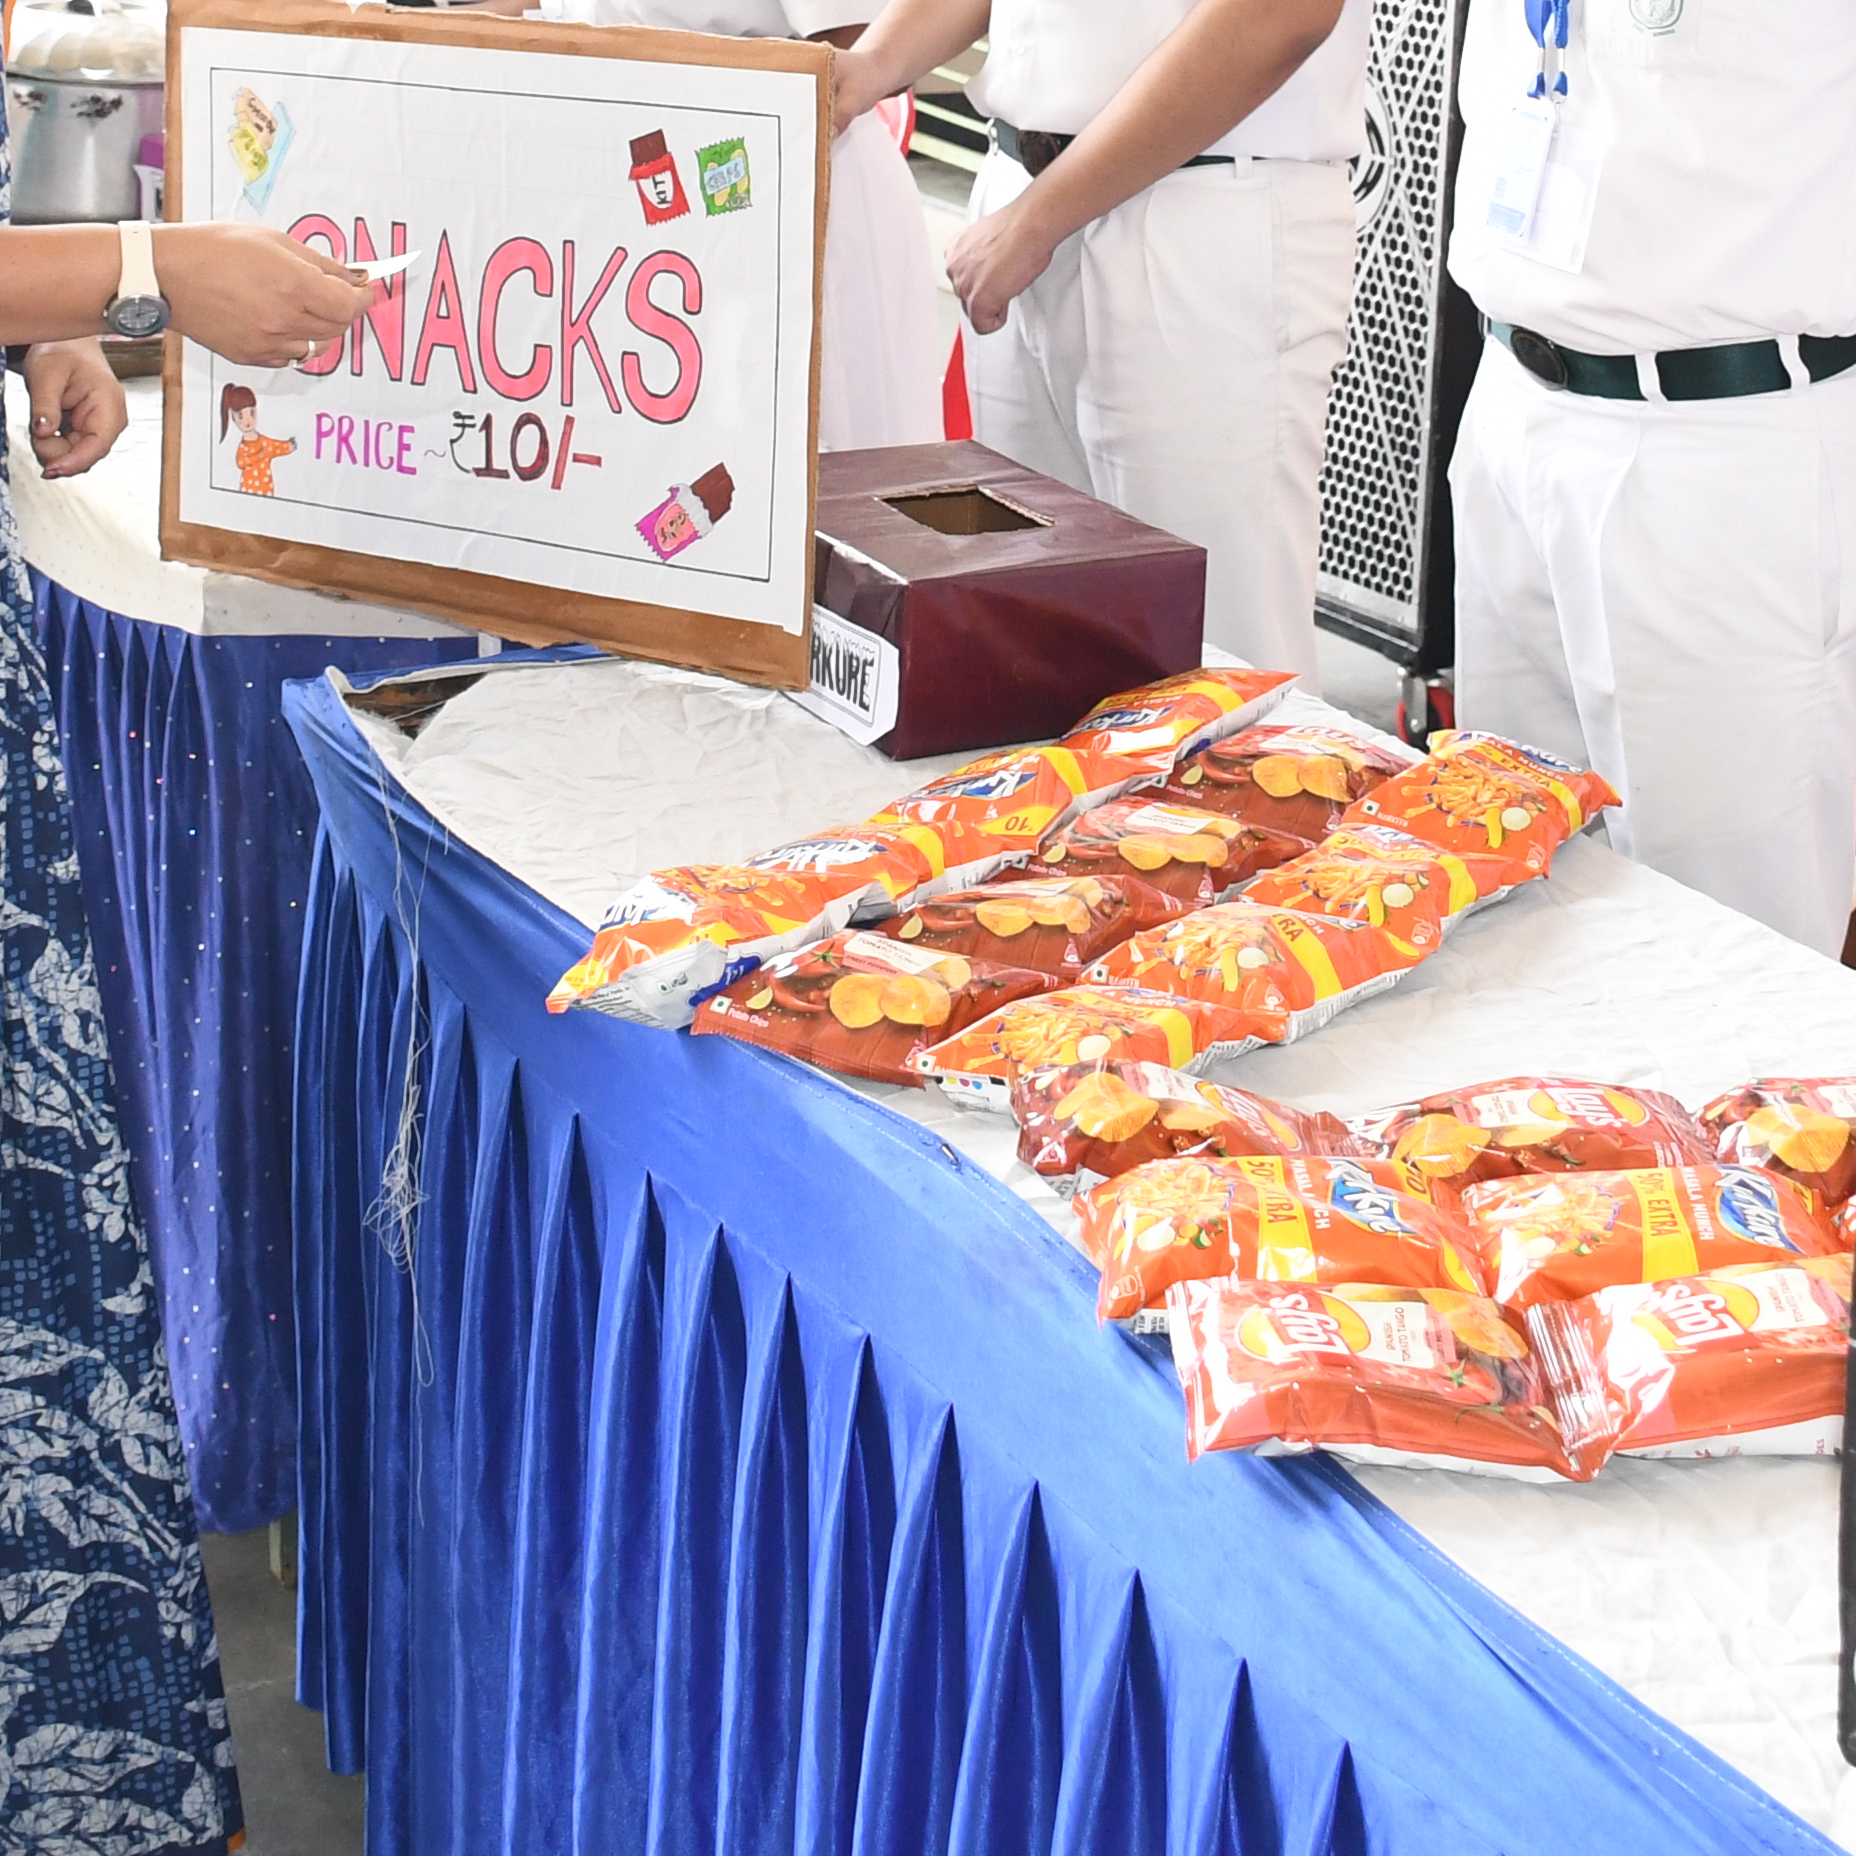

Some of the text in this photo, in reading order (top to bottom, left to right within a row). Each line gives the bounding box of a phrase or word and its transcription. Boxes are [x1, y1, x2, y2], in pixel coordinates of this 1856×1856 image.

[652, 175, 672, 205] KIT
[314, 410, 417, 475] PRICE
[1499, 757, 1552, 787] EXTRA
[1518, 756, 1565, 782] MUNCH
[1121, 993, 1177, 1008] MUNCH
[728, 1006, 770, 1028] Potato Chips
[1649, 1199, 1681, 1238] EXTRA
[1690, 1202, 1715, 1241] MUNCH
[1269, 1292, 1345, 1354] Lay's
[1394, 1307, 1409, 1333] TANGO
